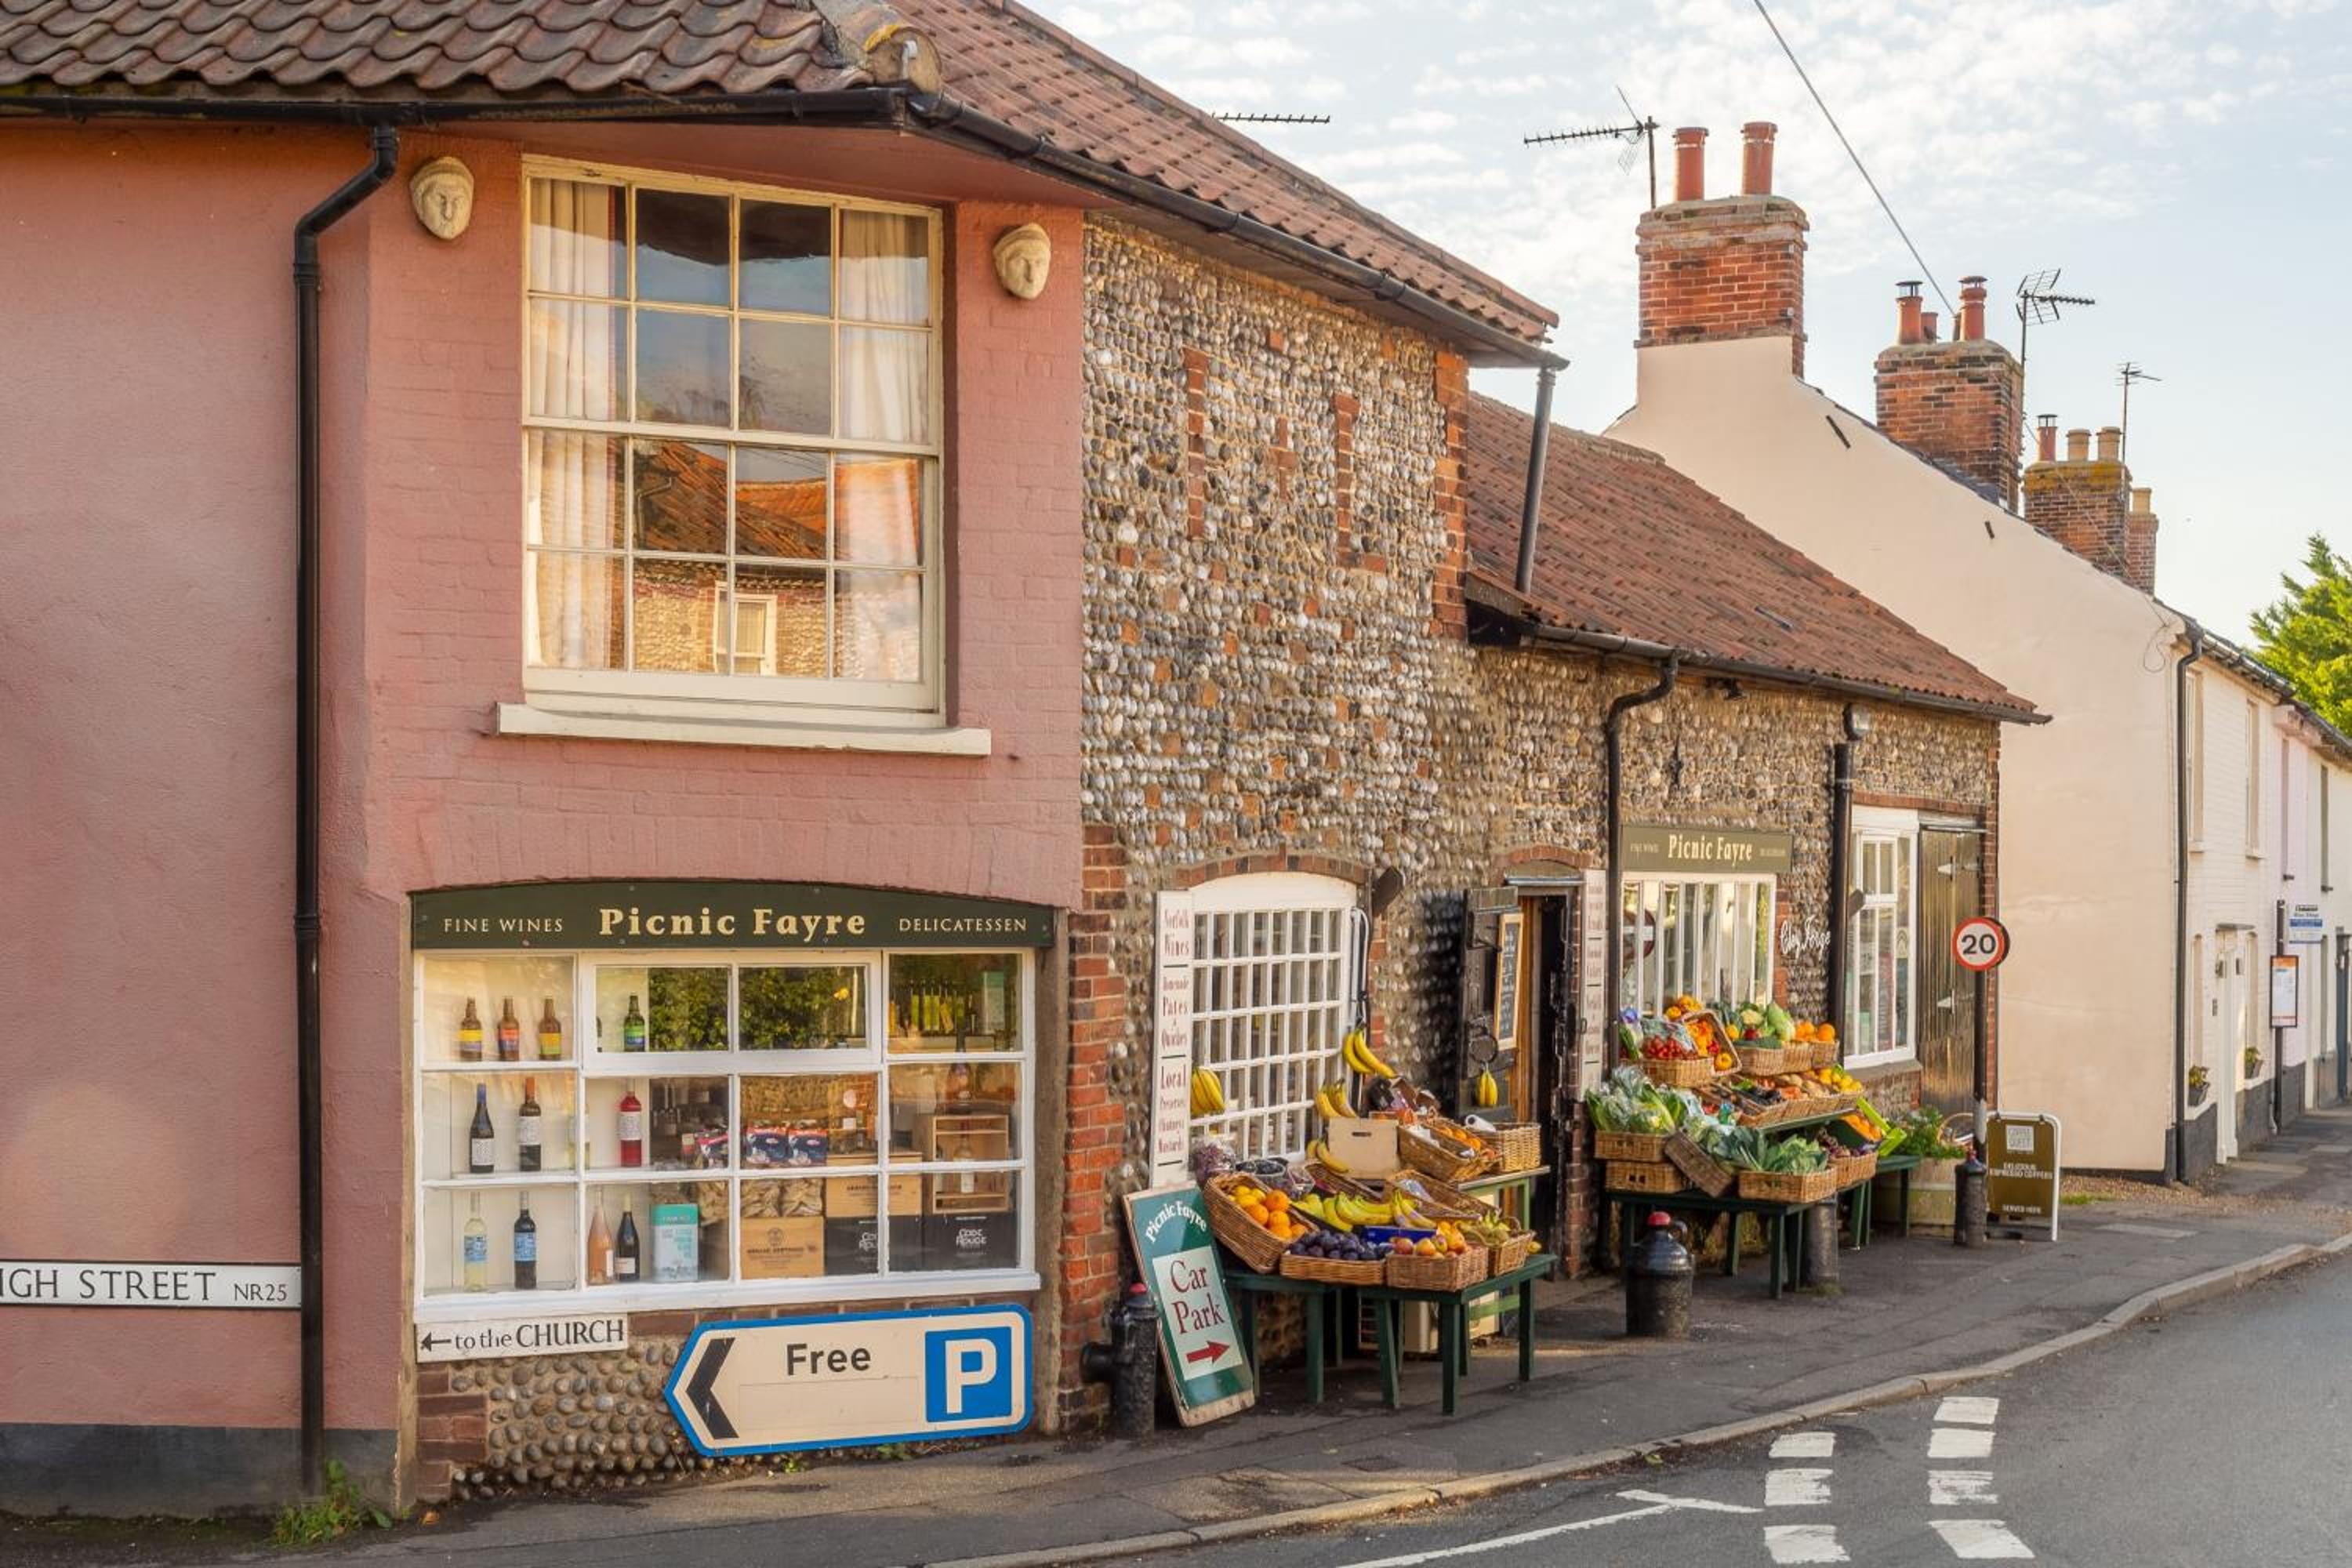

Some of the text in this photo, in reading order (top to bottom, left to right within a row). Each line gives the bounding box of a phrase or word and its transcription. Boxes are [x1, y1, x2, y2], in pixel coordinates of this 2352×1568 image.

[1668, 834, 1753, 868] Picnic Fayre
[443, 918, 564, 933] FINE WINES
[599, 907, 866, 942] Picnic Fayre
[898, 917, 1027, 932] DELICATESSEN
[1164, 934, 1189, 956] Wines
[1962, 934, 1996, 954] 20
[1160, 1064, 1186, 1091] Local
[1145, 1200, 1207, 1243] Picnic Fayre
[79, 1269, 216, 1301] STREET
[234, 1283, 288, 1302] NR25
[1171, 1260, 1208, 1293] Car
[1171, 1292, 1225, 1334] Park
[455, 1319, 624, 1350] to the CHURCH
[786, 1343, 871, 1376] Free
[945, 1338, 997, 1414] P
